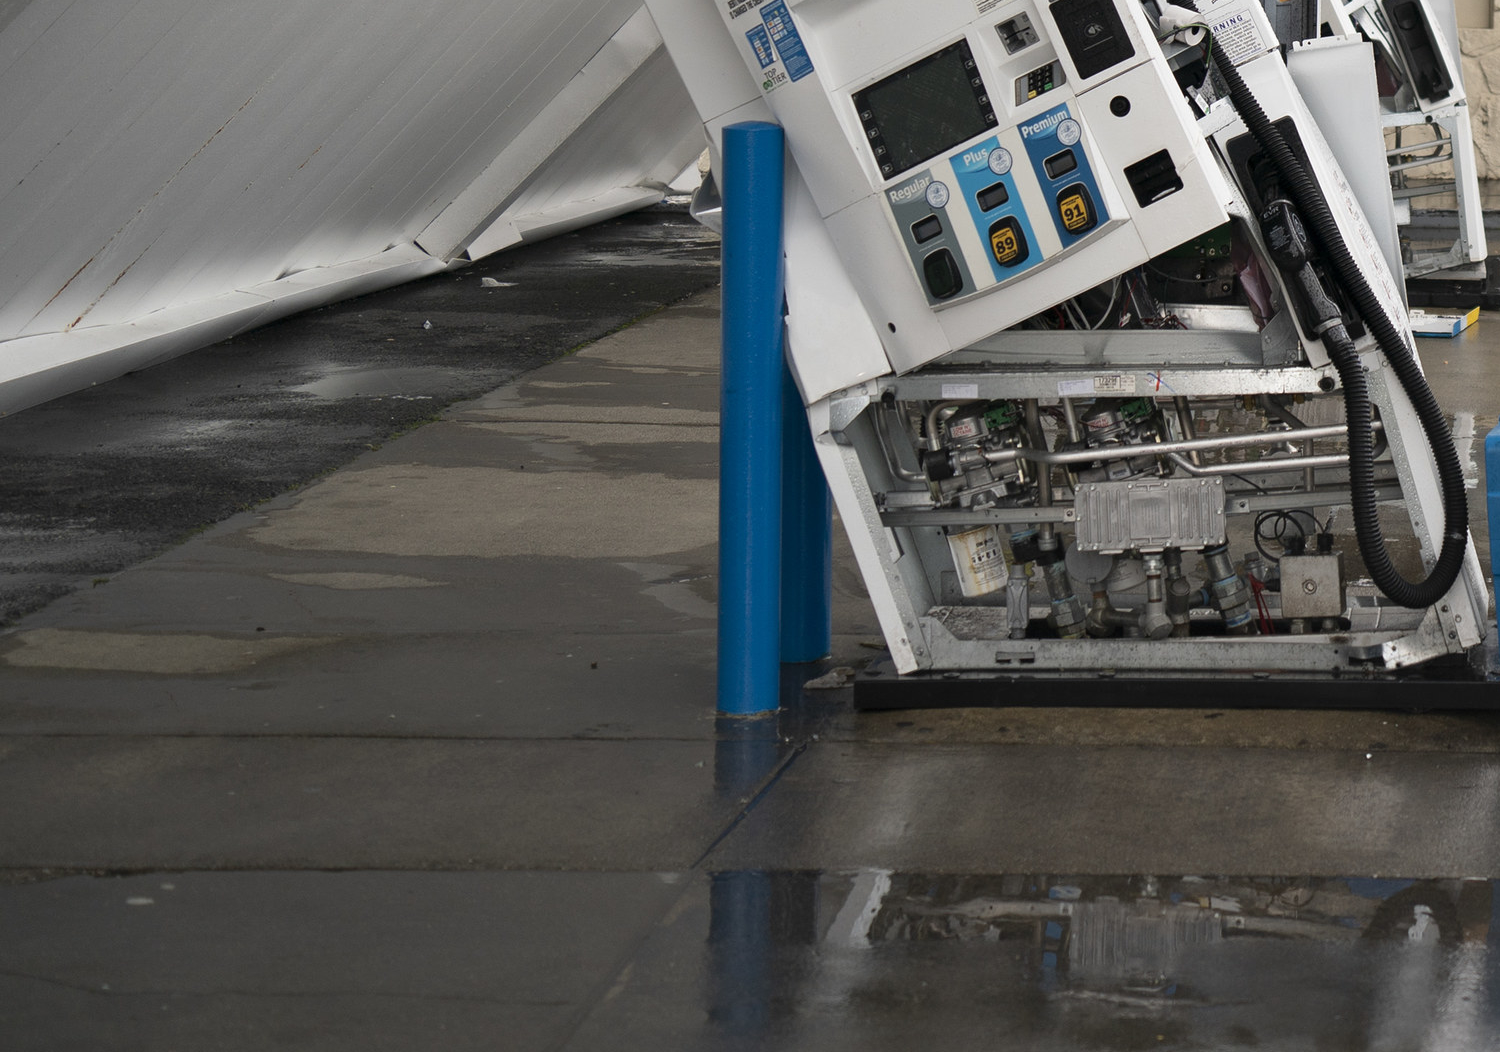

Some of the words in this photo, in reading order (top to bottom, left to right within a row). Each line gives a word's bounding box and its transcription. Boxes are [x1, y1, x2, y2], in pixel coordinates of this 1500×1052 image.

[1213, 15, 1243, 33] RNING
[764, 68, 776, 79] TOP
[772, 72, 787, 84] TIER
[1021, 109, 1068, 138] Premium
[963, 147, 988, 166] Plus
[889, 175, 930, 203] Regular
[1064, 203, 1084, 222] 91
[1264, 206, 1279, 218] EVR
[996, 236, 1015, 254] 89
